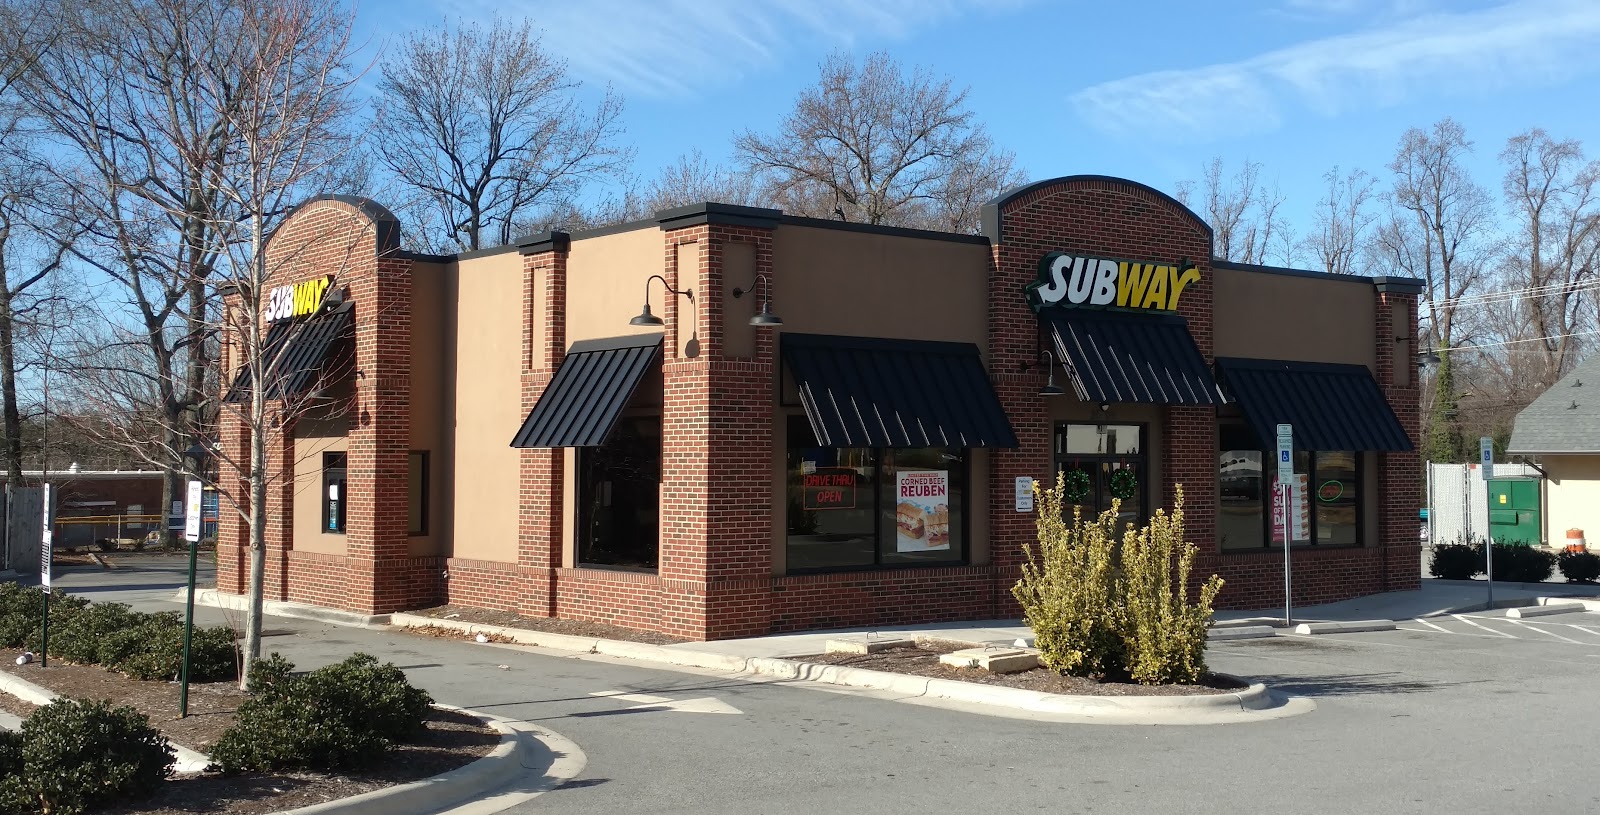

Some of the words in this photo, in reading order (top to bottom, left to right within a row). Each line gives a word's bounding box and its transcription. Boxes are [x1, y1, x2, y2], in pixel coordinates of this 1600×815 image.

[1037, 254, 1202, 311] SUBWAY
[265, 275, 329, 321] SUBWAY
[805, 474, 831, 487] DRIVE
[832, 474, 854, 486] THRU
[901, 477, 928, 486] CORNED
[928, 477, 945, 485] BEEF
[817, 489, 843, 503] OPEN
[901, 485, 946, 497] REUBEN
